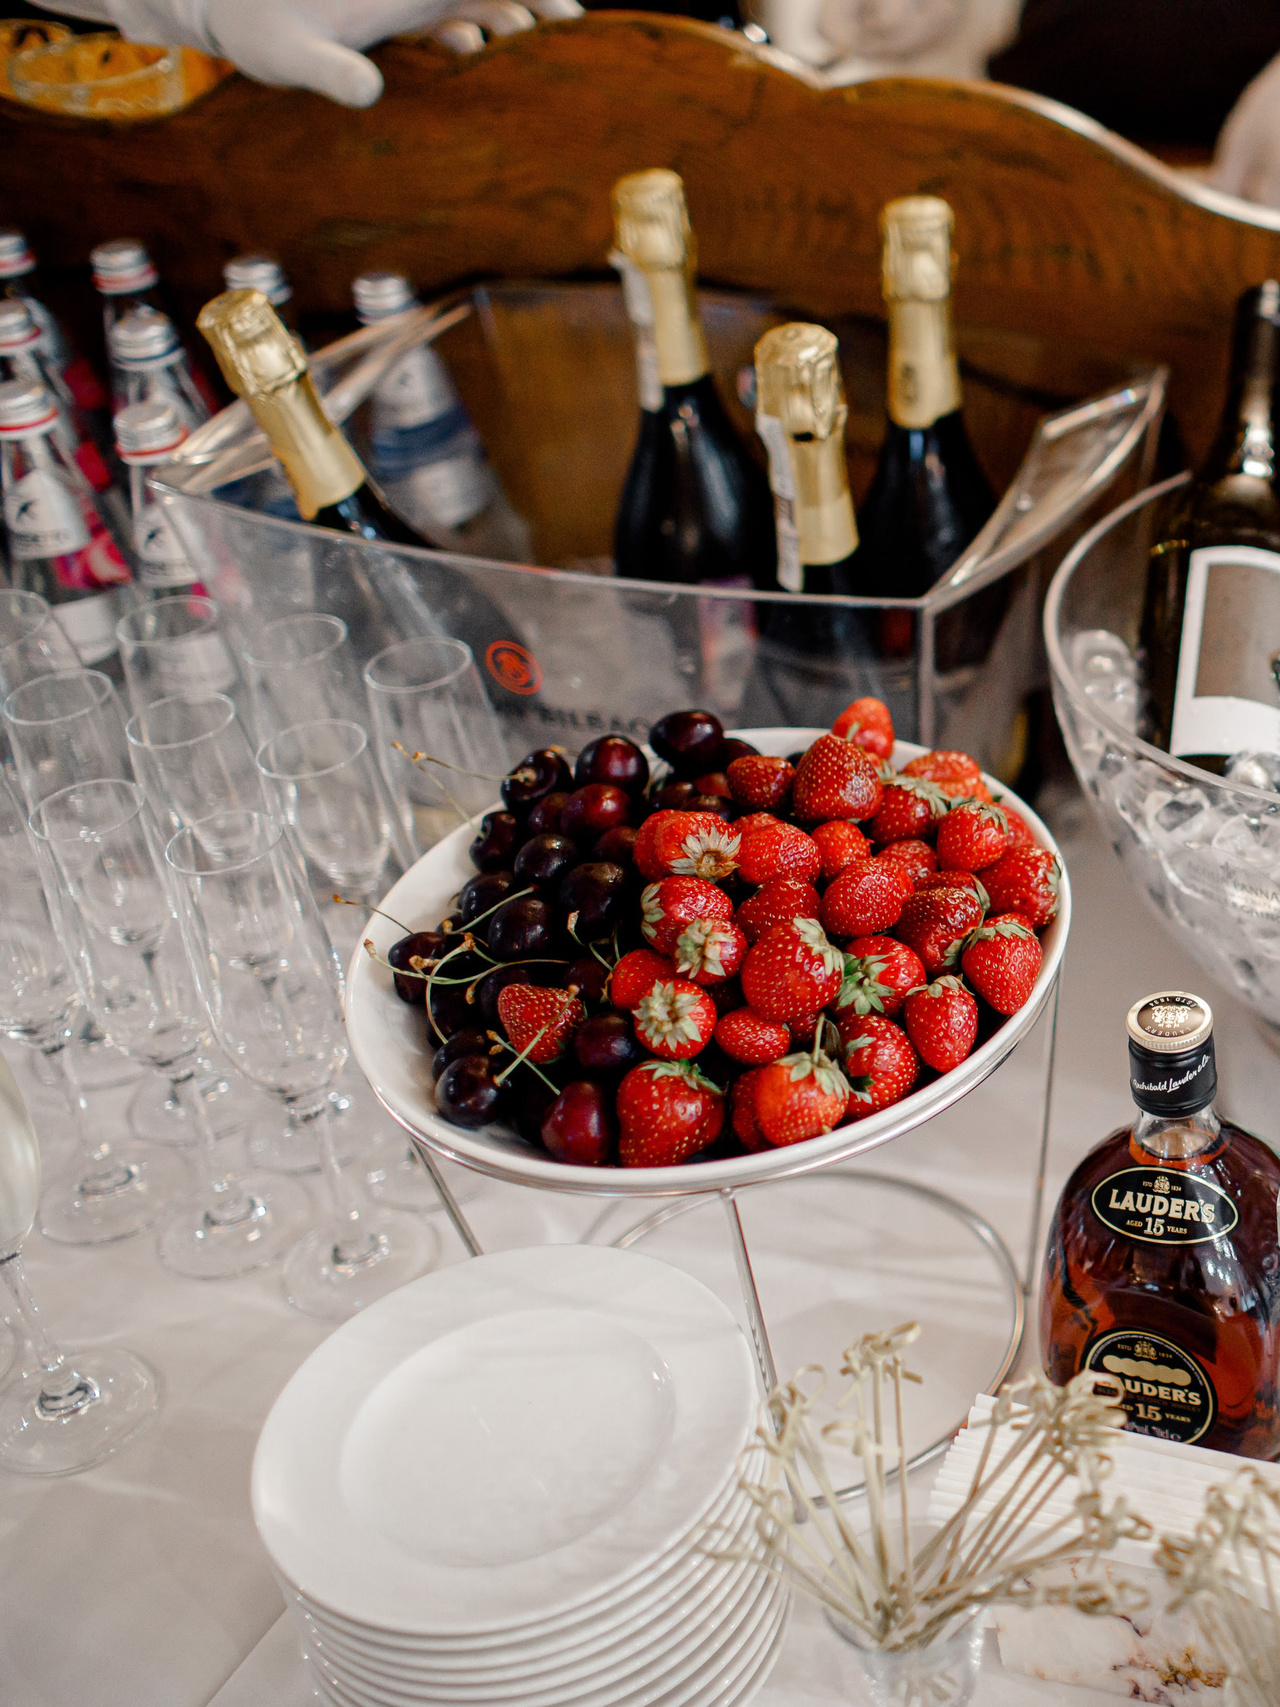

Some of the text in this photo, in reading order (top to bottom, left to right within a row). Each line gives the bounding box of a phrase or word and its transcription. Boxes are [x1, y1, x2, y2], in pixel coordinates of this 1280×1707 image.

[1108, 1188, 1216, 1224] LAUDER'S
[1126, 1216, 1188, 1236] AGED 15 YEARS
[1134, 1403, 1162, 1422] 15
[1164, 1412, 1192, 1423] YEARS
